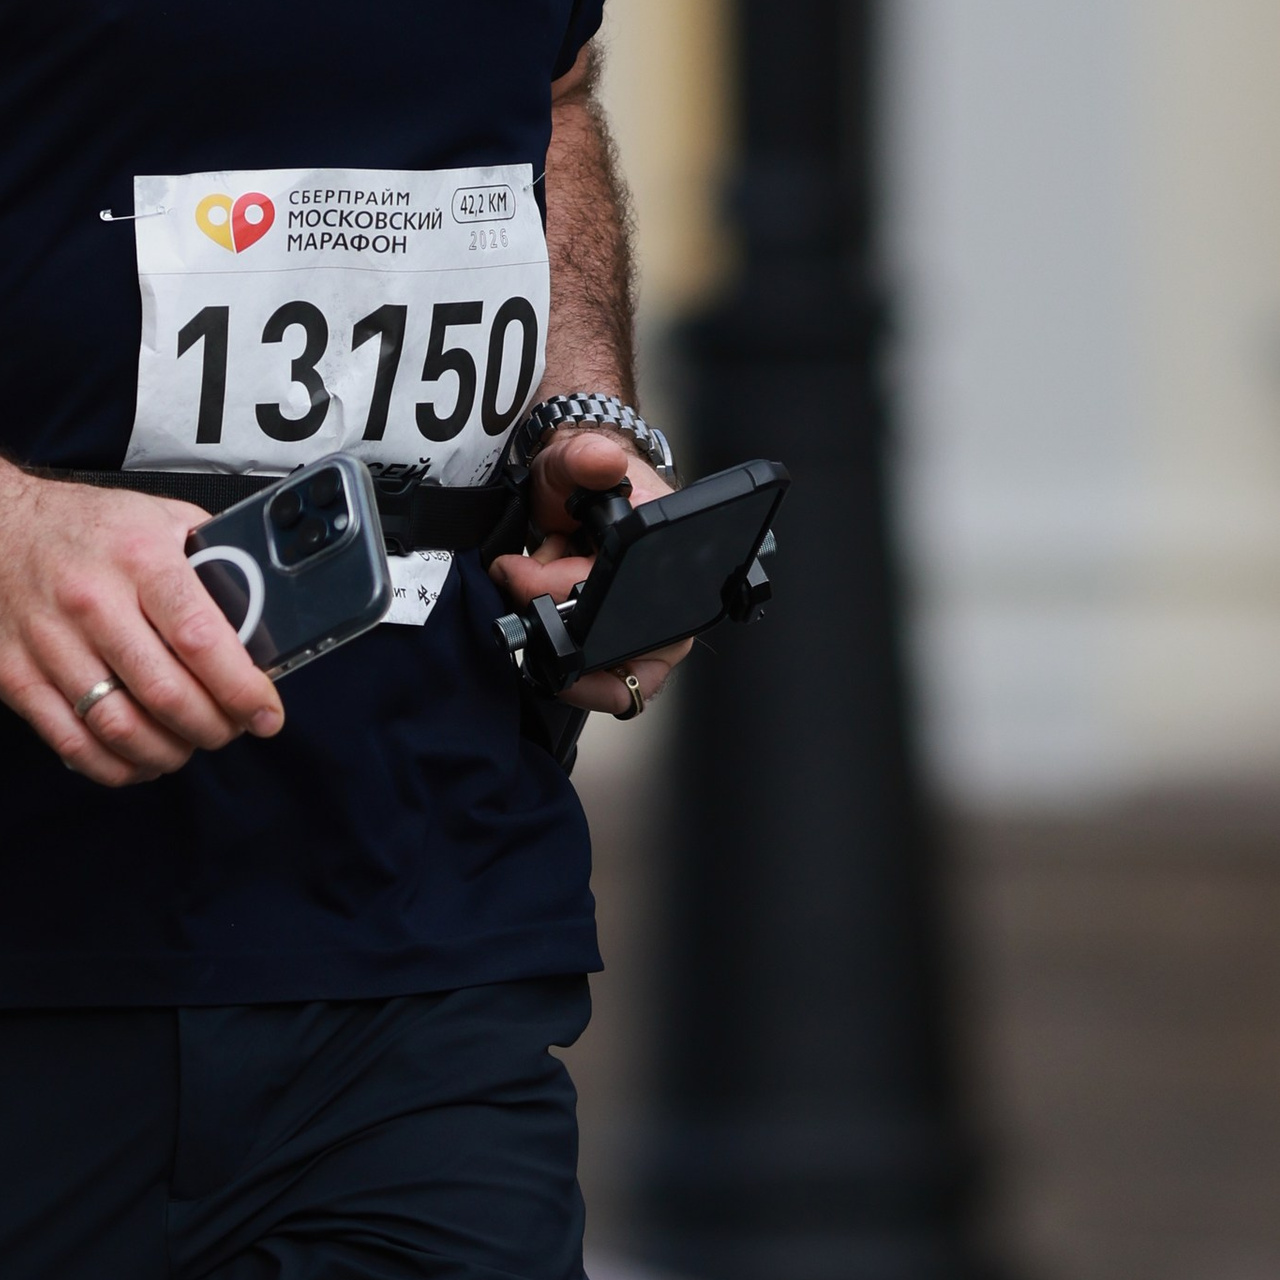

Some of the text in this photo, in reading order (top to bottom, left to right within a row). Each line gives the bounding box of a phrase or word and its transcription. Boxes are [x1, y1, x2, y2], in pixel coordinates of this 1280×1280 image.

[289, 188, 410, 206] СБЕРПРАЙМ
[460, 193, 484, 217] 42,2
[288, 207, 442, 231] МОСКОВСКИЙ
[287, 232, 407, 254] МАРАФОН
[468, 228, 509, 251] 2026
[176, 296, 539, 445] 13150
